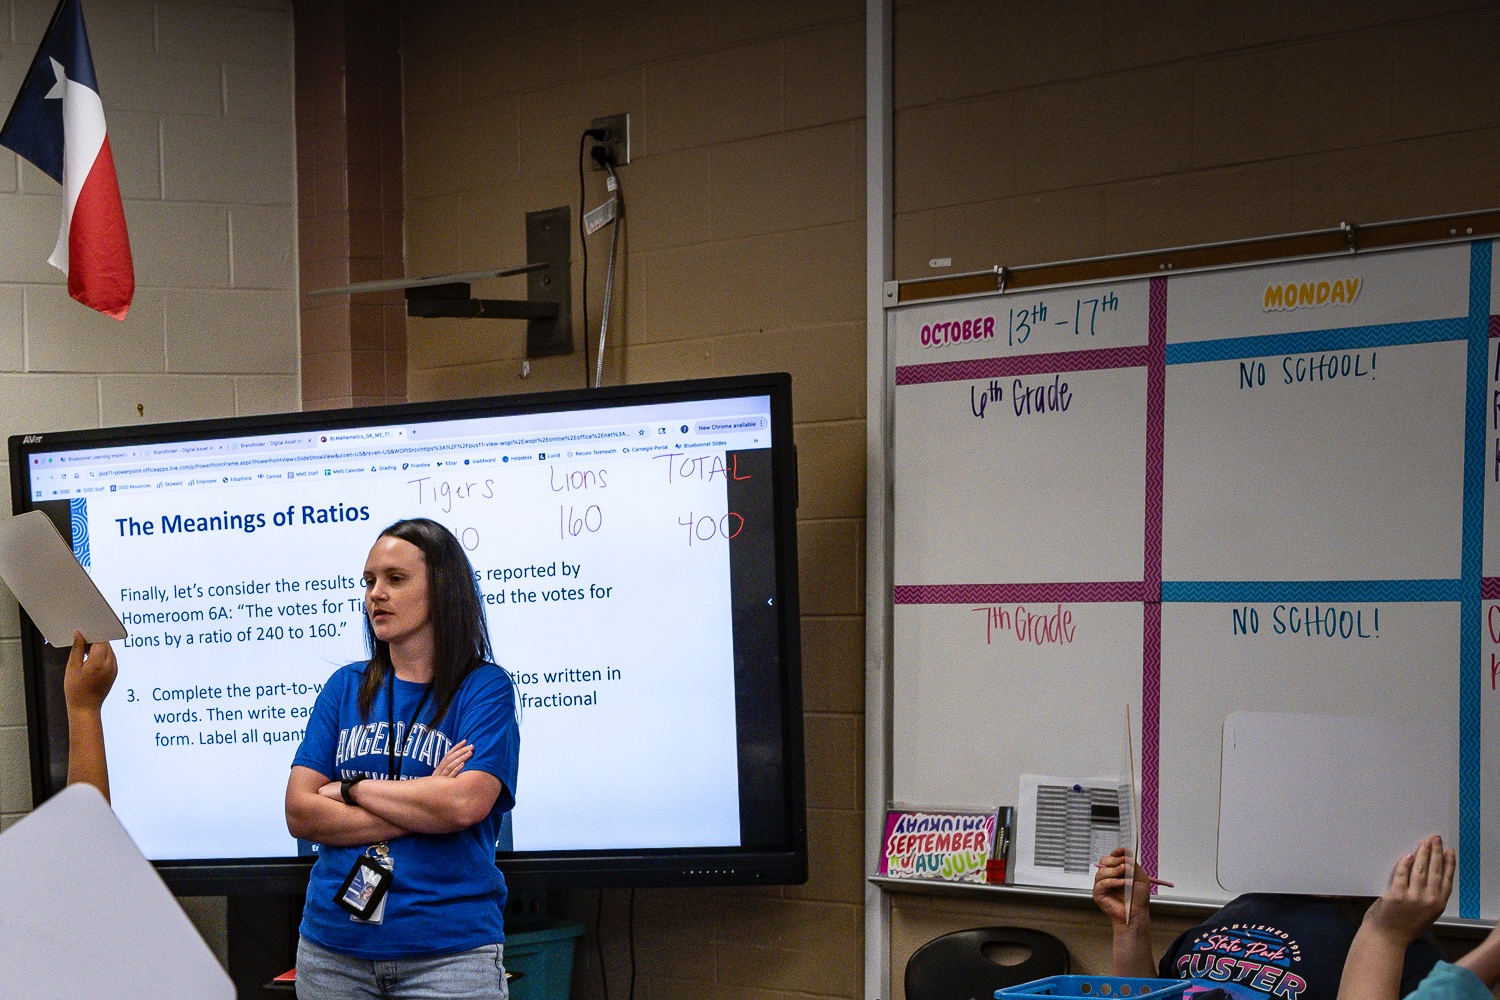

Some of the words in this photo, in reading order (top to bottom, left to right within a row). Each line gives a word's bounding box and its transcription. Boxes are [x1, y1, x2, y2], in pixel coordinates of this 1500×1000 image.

[1264, 277, 1361, 310] MONDAY
[921, 316, 995, 345] OCTOBER
[1239, 359, 1267, 390] NO
[1282, 352, 1378, 385] SCHOOL!
[1013, 375, 1072, 416] Grade
[734, 421, 756, 429] available
[408, 477, 495, 513] Tigers
[550, 465, 608, 492] Lions
[652, 453, 752, 484] TOTAL
[115, 517, 154, 536] The
[161, 511, 265, 534] Meanings
[273, 506, 295, 526] of
[302, 503, 370, 525] Ratios
[560, 505, 602, 540] 160
[678, 512, 745, 546] 400
[487, 562, 556, 582] reported
[561, 561, 580, 579] by
[121, 585, 169, 602] Finally,
[208, 580, 271, 596] consider
[275, 578, 300, 593] the
[305, 575, 355, 591] results
[122, 610, 204, 625] Homeroom
[209, 607, 233, 620] 6A:
[277, 602, 317, 616] votes
[322, 599, 343, 613] for
[1232, 608, 1259, 636] NO
[1273, 605, 1381, 640] SCHOOL!
[124, 635, 160, 648] Lions
[165, 632, 181, 648] by
[186, 634, 194, 644] a
[199, 630, 232, 643] ratio
[237, 627, 252, 642] of
[257, 627, 283, 641] 240
[288, 625, 303, 639] to
[1016, 607, 1077, 646] Grade
[544, 668, 602, 683] written
[607, 666, 621, 680] in
[127, 689, 140, 702] 3.
[152, 685, 222, 702] Complete
[226, 683, 251, 697] the
[522, 691, 597, 708] fractional
[154, 708, 202, 723] words.
[206, 708, 243, 721] Then
[248, 705, 286, 719] write
[888, 831, 986, 856] SEPTEMBER
